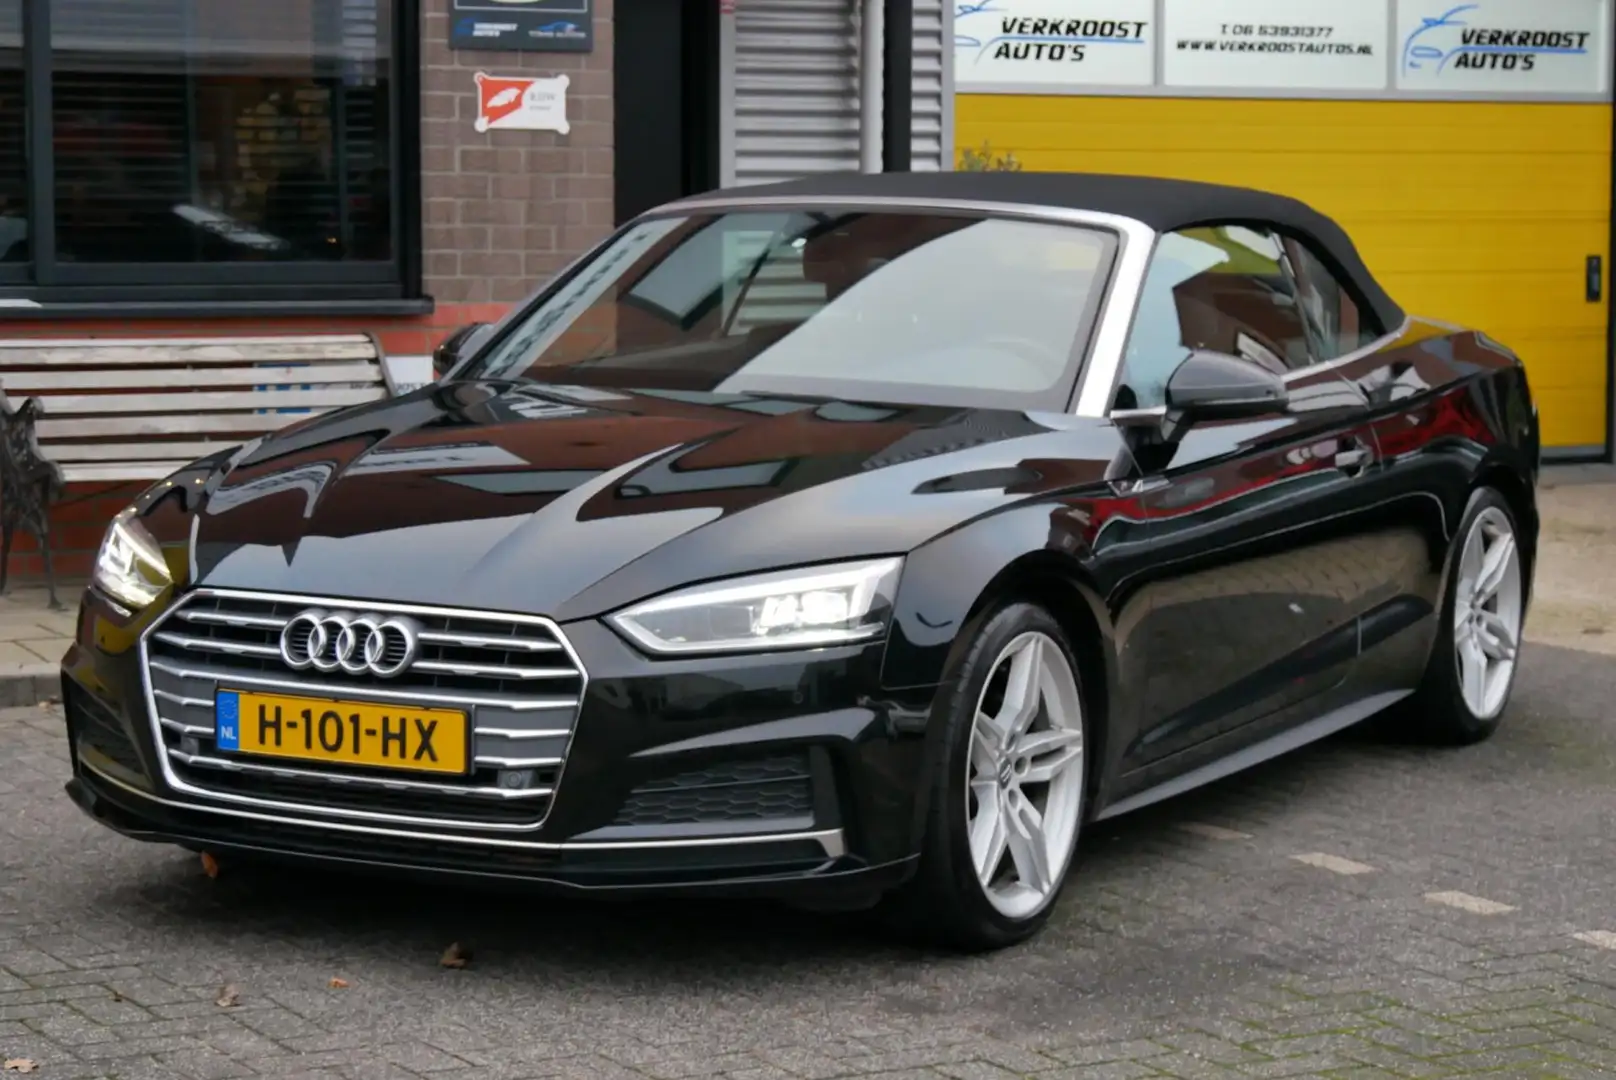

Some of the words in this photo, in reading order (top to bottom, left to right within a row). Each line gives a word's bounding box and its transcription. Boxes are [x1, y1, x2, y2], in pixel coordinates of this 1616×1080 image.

[1001, 17, 1148, 39] VERKROOST
[1460, 28, 1590, 49] VERKROOST
[993, 42, 1086, 62] AUTO'S
[1454, 52, 1536, 71] AUTO'S
[220, 726, 237, 741] NL
[258, 704, 439, 763] H-101-HX
